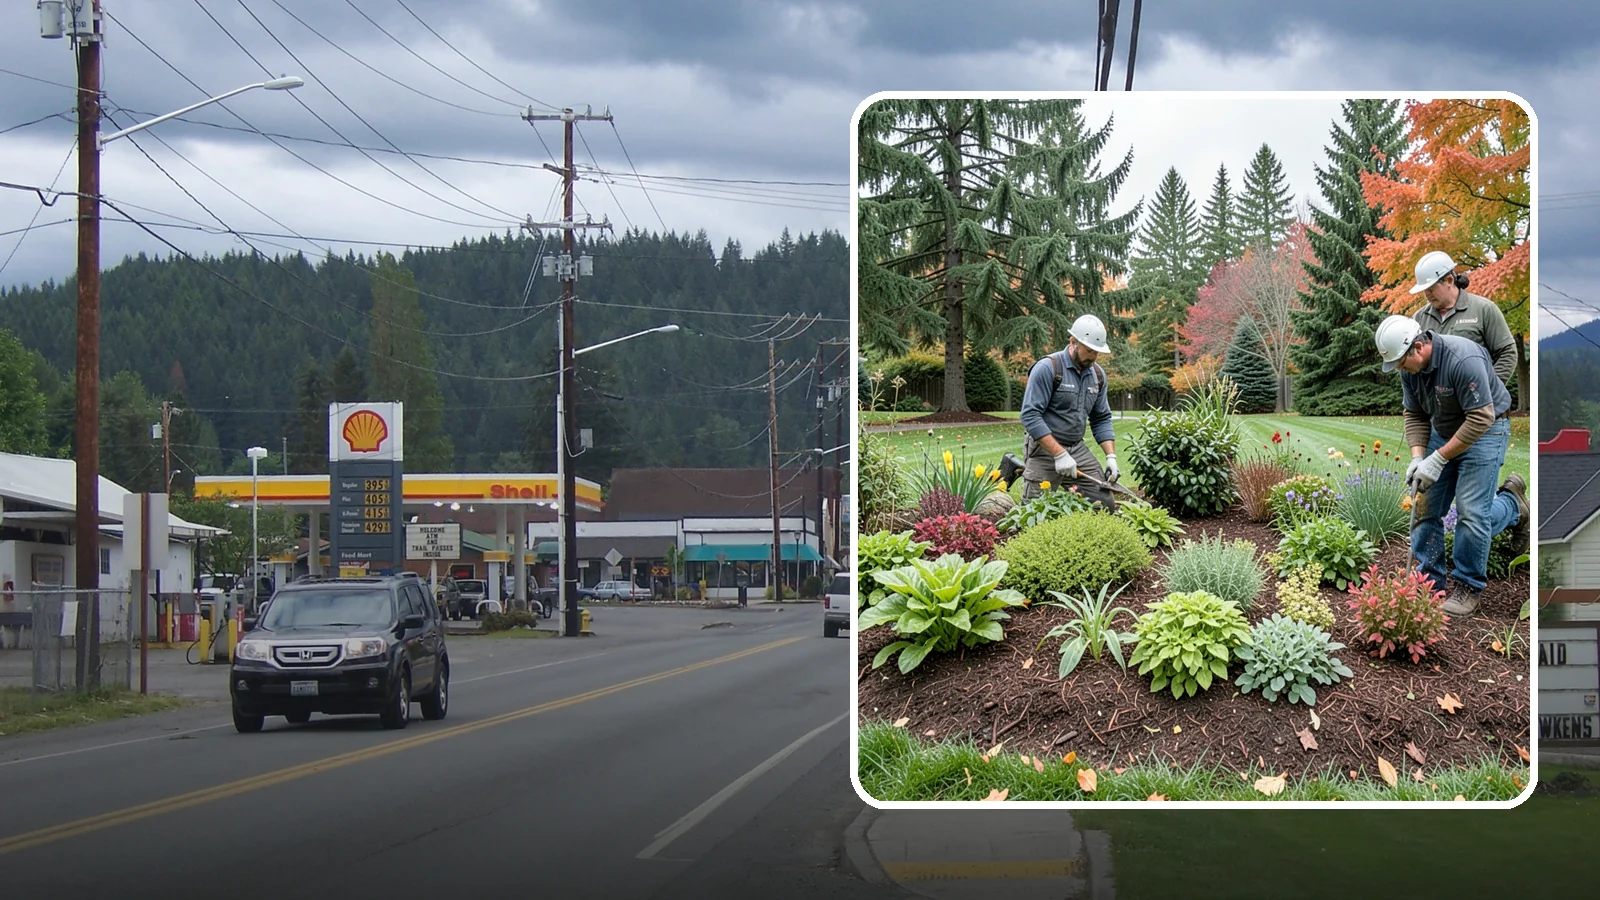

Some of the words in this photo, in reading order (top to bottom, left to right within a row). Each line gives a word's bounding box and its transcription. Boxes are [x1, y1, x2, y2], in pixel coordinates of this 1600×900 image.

[365, 480, 384, 490] 395
[490, 484, 547, 499] Shell
[365, 494, 384, 504] 405
[365, 508, 384, 518] 415
[365, 522, 384, 533] 429
